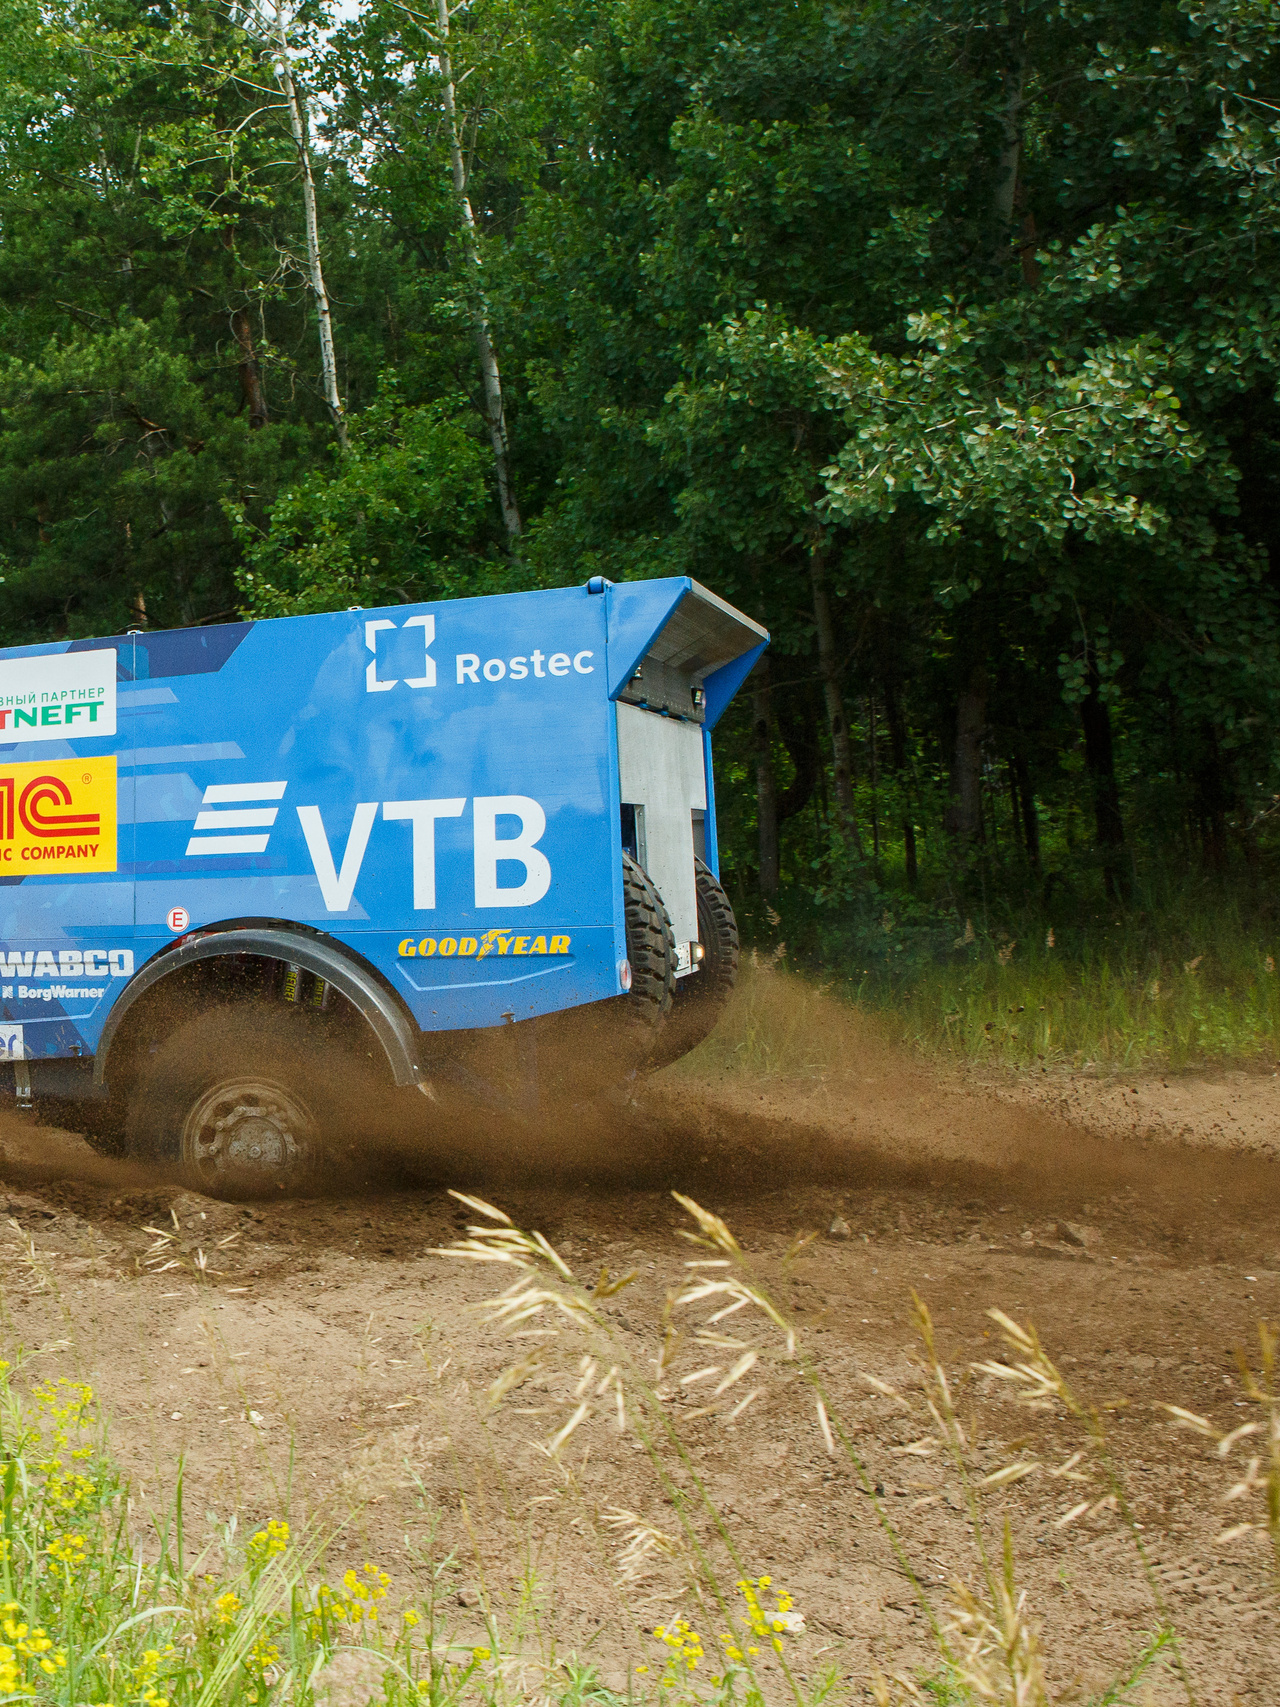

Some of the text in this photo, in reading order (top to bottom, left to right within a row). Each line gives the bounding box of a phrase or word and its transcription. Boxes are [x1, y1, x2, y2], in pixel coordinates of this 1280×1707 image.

[456, 649, 595, 684] Rostec
[41, 687, 105, 704] ПАРТНЕР
[21, 844, 99, 861] COMPANY
[297, 795, 552, 912] VTB
[173, 912, 183, 927] E
[18, 985, 105, 1001] BorgWarner
